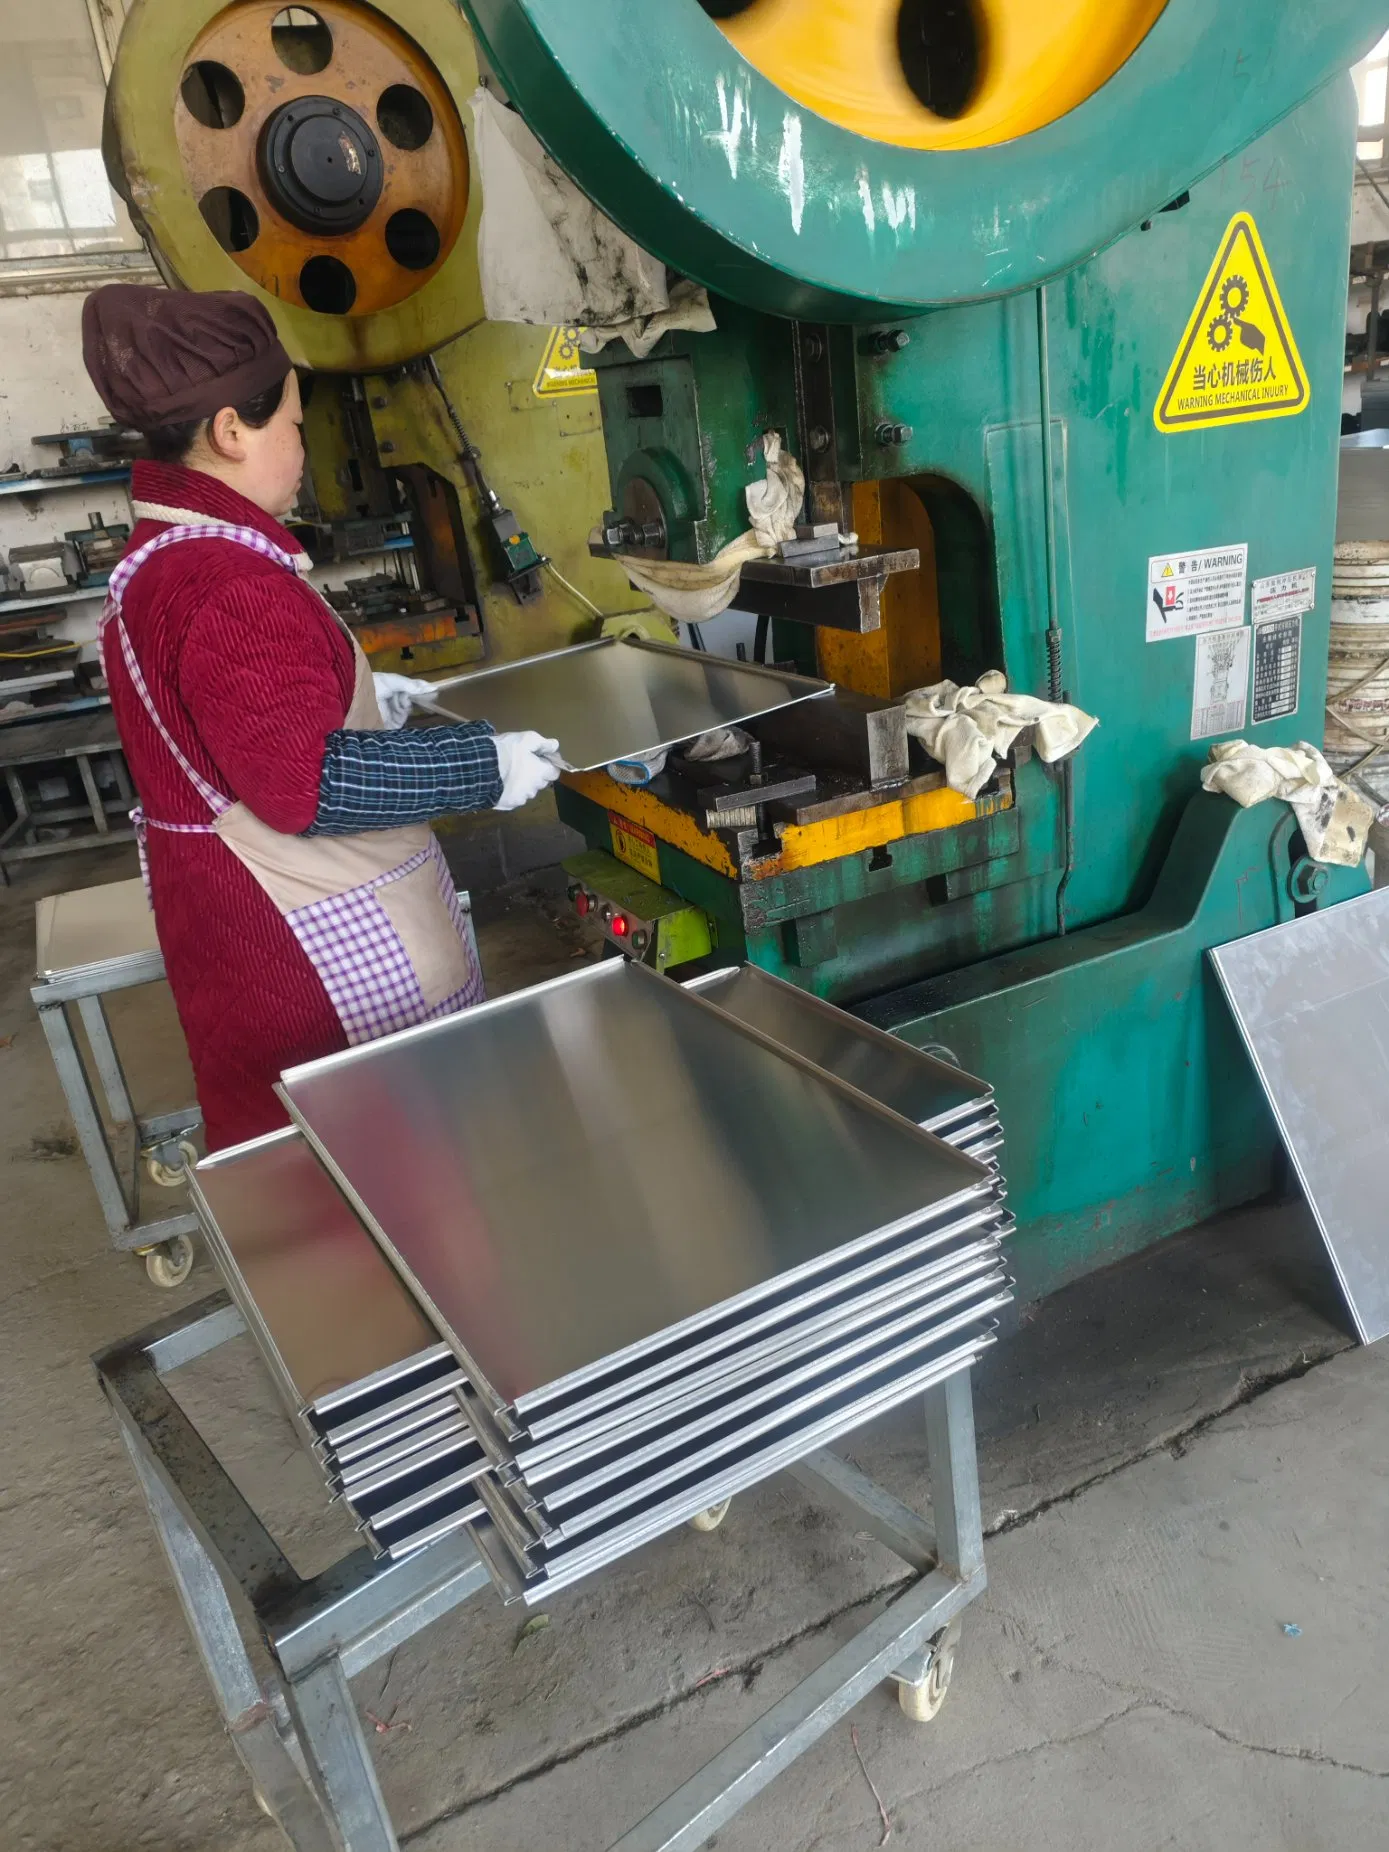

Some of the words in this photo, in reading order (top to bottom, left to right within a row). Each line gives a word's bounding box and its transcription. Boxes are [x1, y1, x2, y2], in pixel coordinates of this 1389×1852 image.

[1192, 356, 1277, 391] 当心机械伤人
[1177, 394, 1213, 410] WARNING
[1214, 388, 1261, 404] MECHANICAL
[1204, 553, 1243, 569] WARNING
